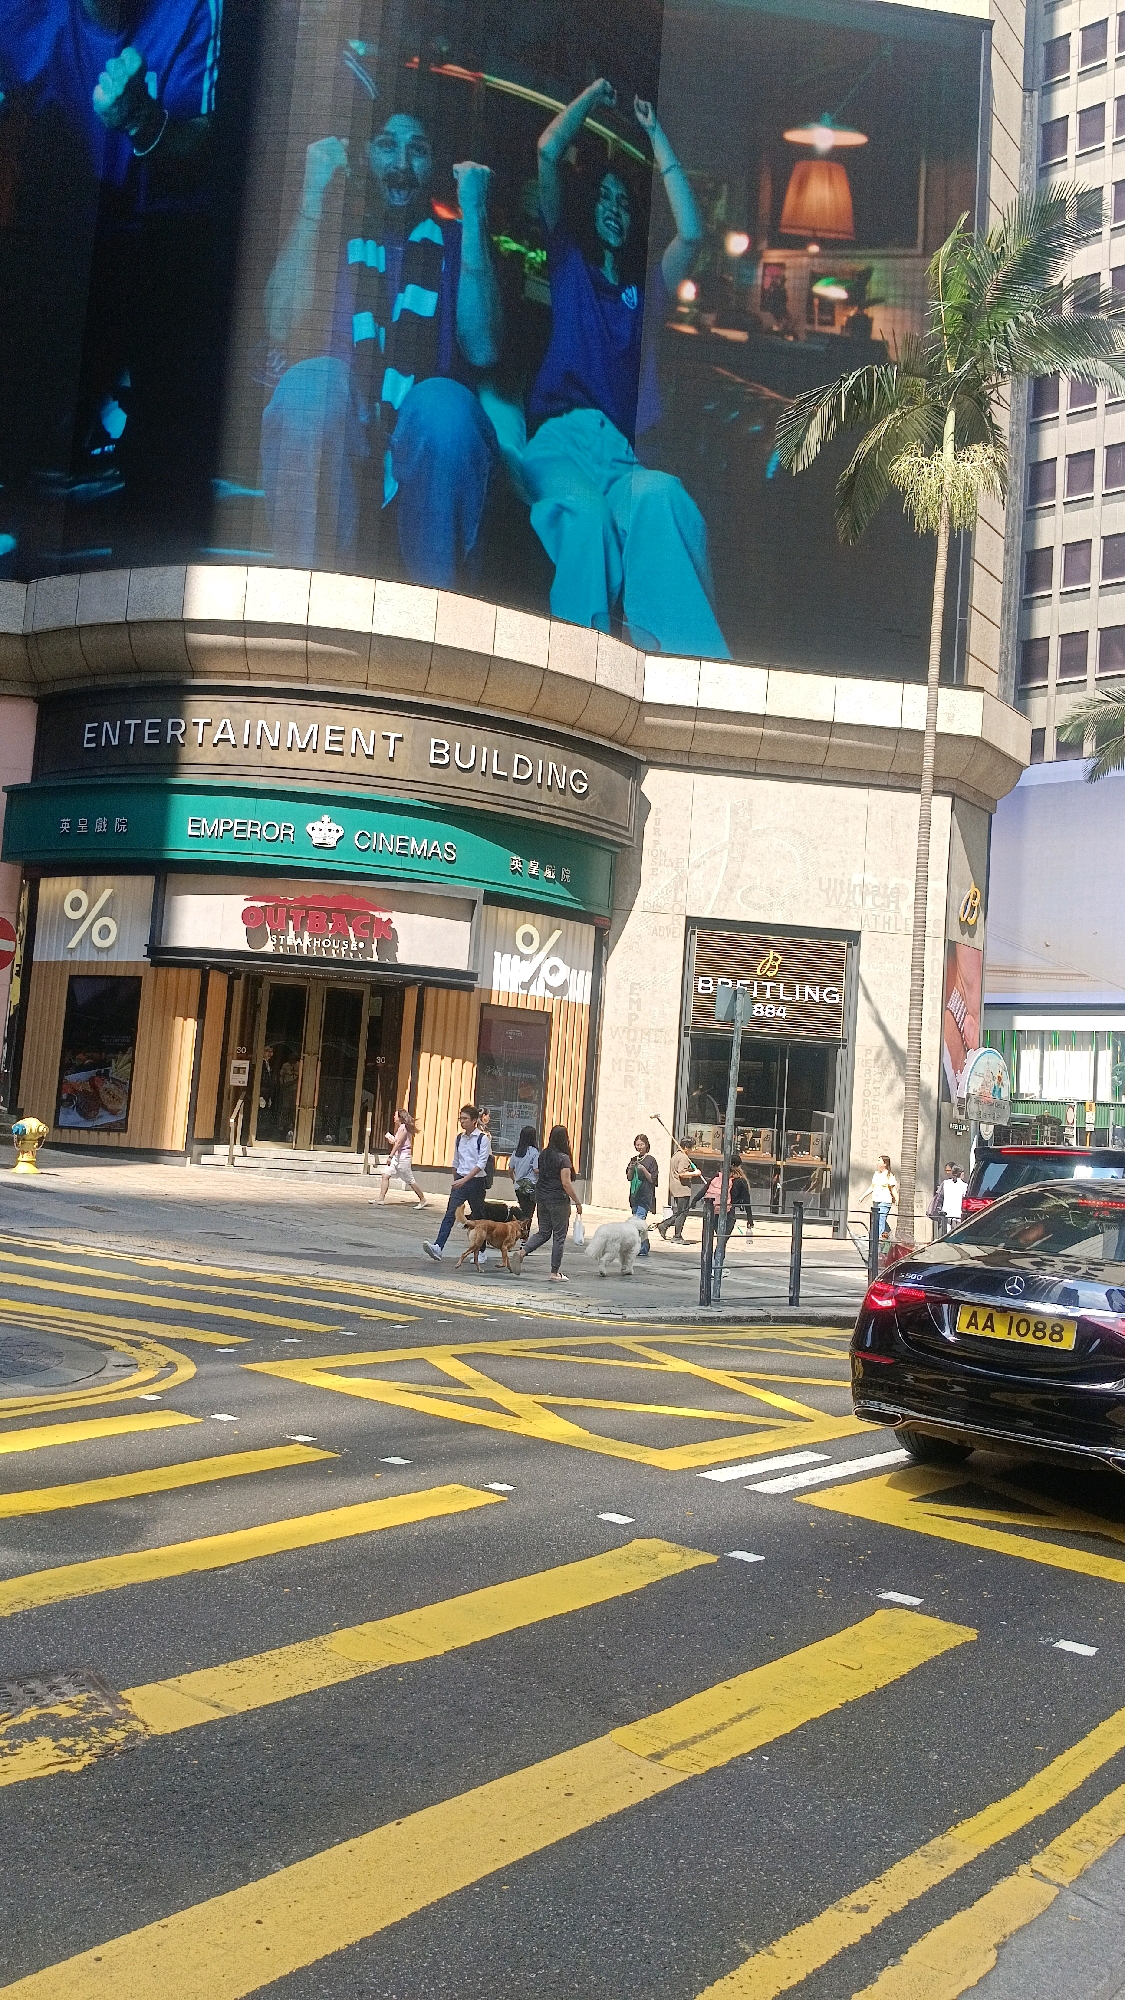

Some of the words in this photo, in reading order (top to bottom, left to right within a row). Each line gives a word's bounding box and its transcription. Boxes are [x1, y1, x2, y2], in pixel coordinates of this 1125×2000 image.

[83, 717, 404, 760] ENTERTAINMENT
[429, 737, 589, 795] BUILDING
[187, 816, 295, 843] EMPEROR
[354, 829, 457, 862] CINEMAS
[241, 905, 393, 941] OUTBACK
[752, 1003, 787, 1020] 884
[236, 1046, 247, 1054] 30
[375, 1056, 386, 1064] 30
[966, 1310, 996, 1334] AA
[1007, 1315, 1064, 1344] 1088
